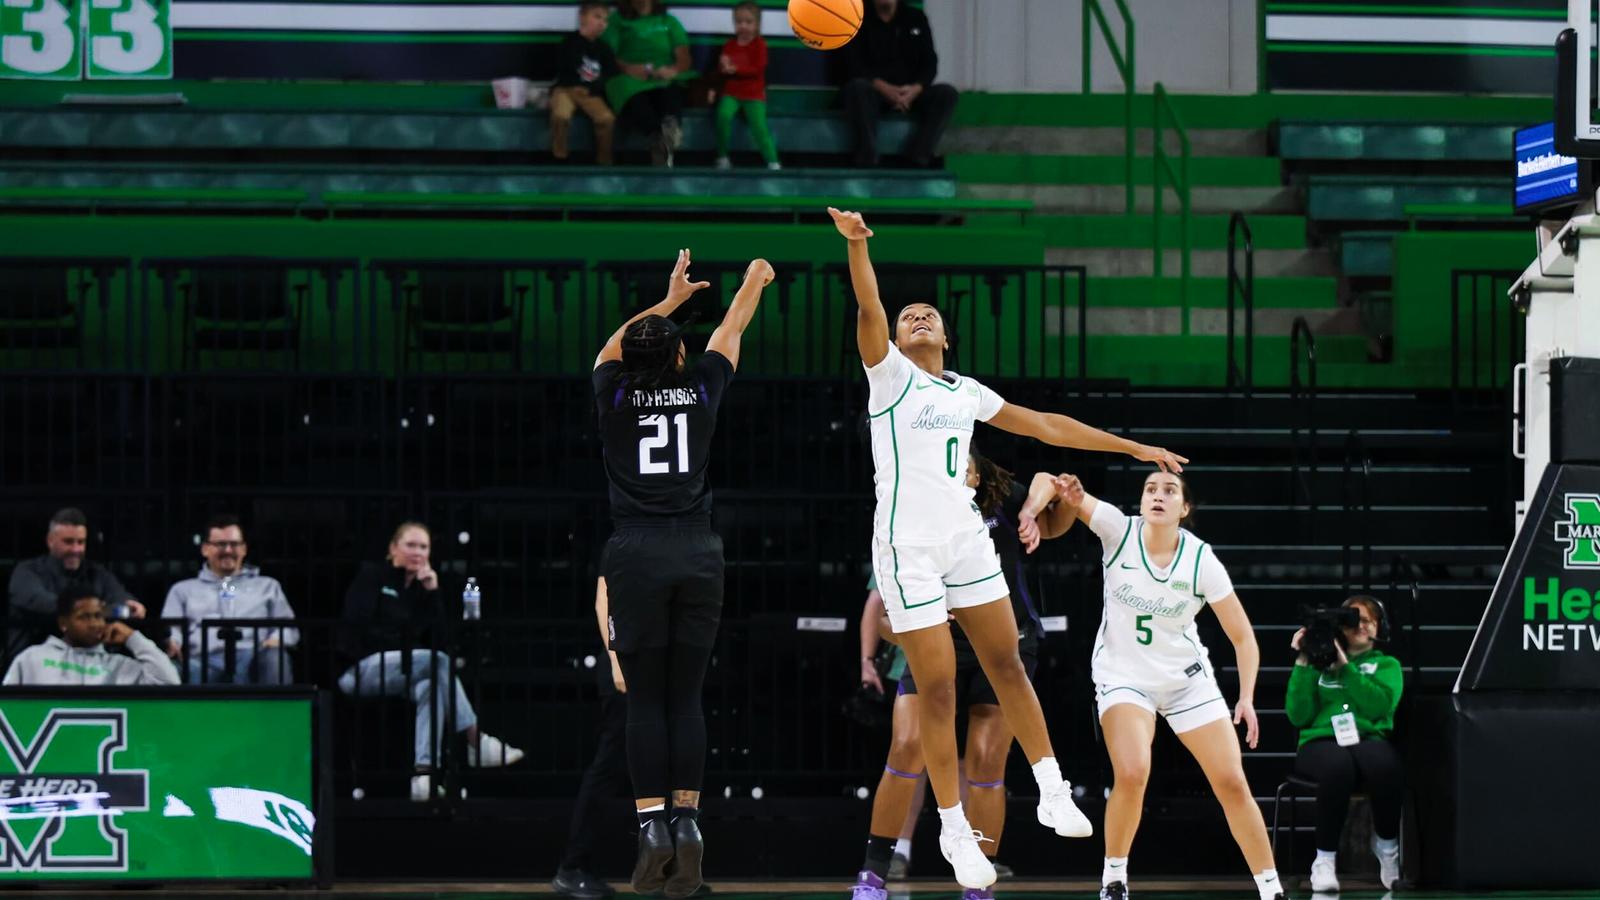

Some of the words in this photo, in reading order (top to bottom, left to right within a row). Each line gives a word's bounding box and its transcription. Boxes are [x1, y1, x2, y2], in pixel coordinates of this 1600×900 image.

[638, 413, 689, 474] 21
[946, 437, 958, 478] 0
[1113, 583, 1188, 618] Marshall
[1524, 577, 1600, 621] He
[1136, 615, 1153, 645] 5
